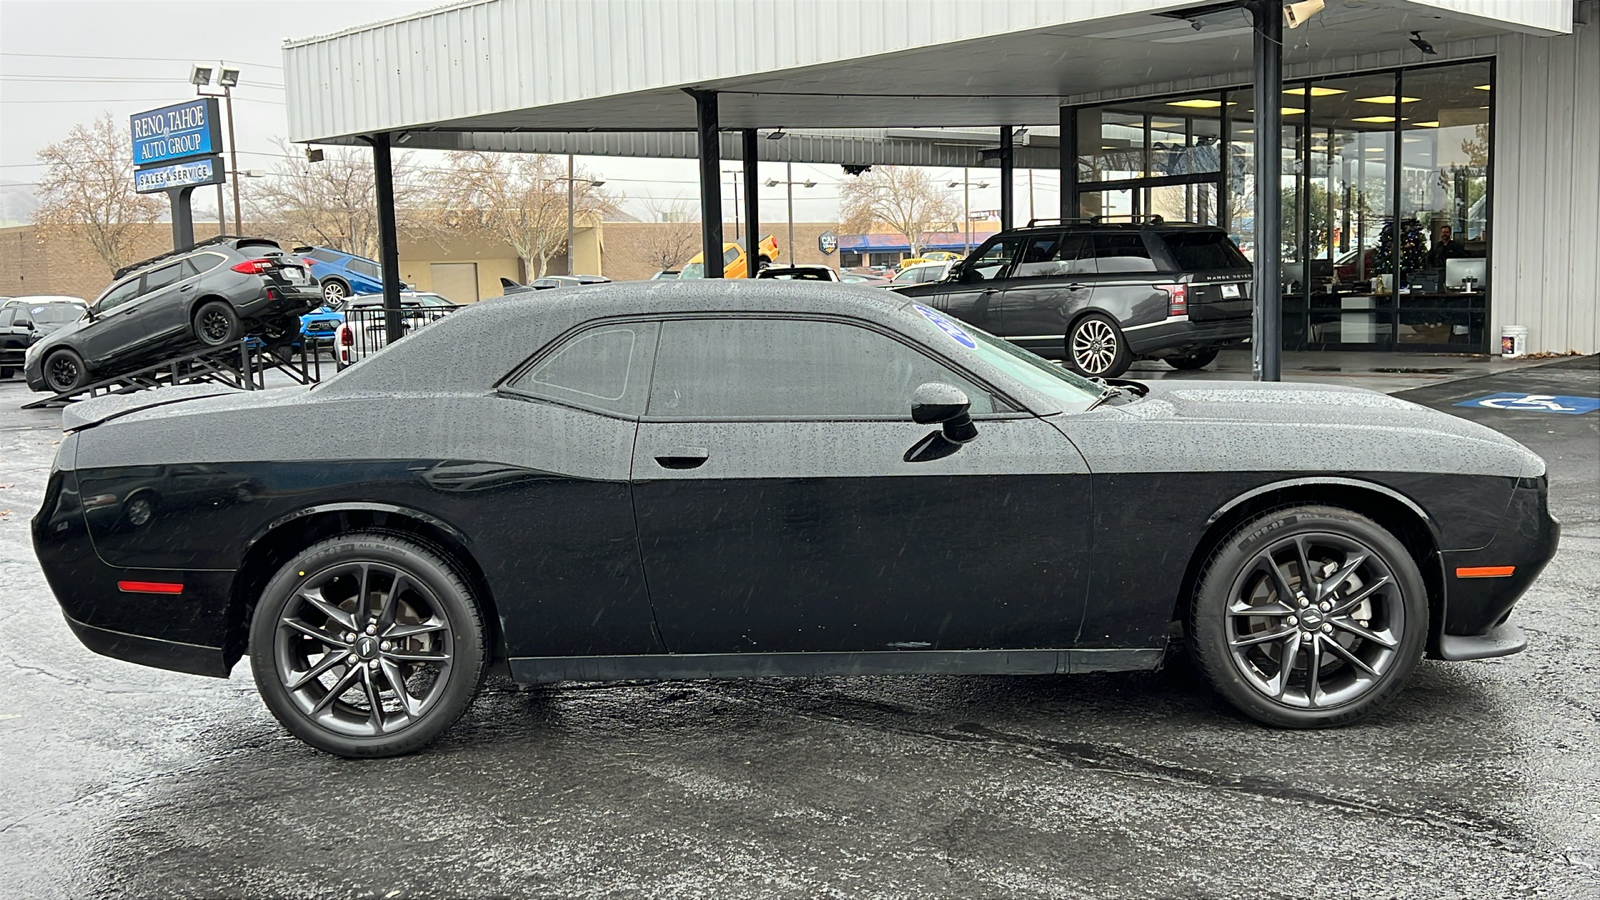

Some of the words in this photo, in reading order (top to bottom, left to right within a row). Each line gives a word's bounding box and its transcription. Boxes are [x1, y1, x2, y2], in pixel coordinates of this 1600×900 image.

[134, 114, 164, 138] RENO
[168, 105, 204, 131] TAHOE
[141, 140, 166, 159] AUTO
[168, 133, 201, 154] GROUP
[140, 173, 164, 186] SALES
[166, 171, 172, 182] &
[173, 166, 208, 181] SERVICE
